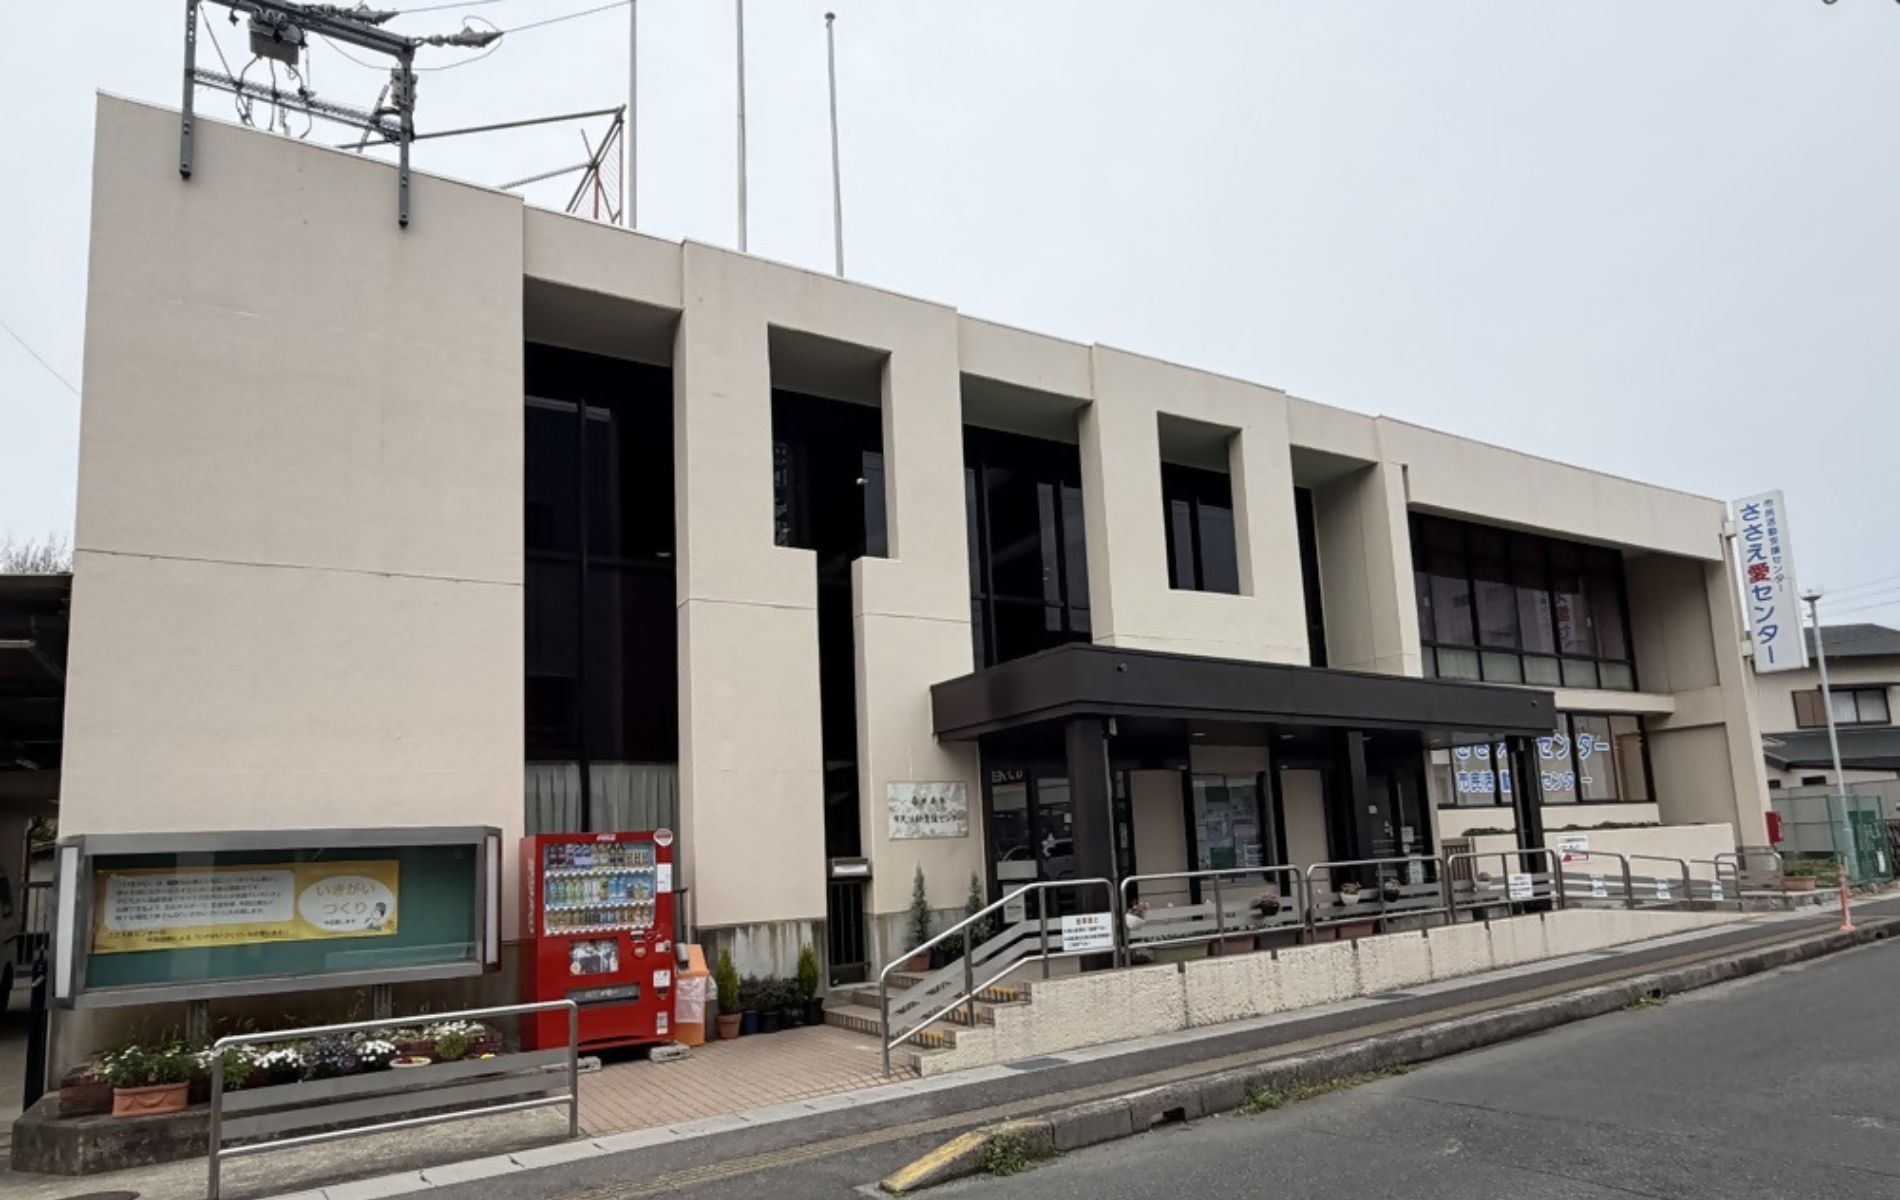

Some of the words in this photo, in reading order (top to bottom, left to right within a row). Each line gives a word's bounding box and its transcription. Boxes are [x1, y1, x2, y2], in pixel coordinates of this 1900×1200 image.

[1740, 502, 1778, 664] ささえ愛センター
[316, 882, 376, 897] いきがい
